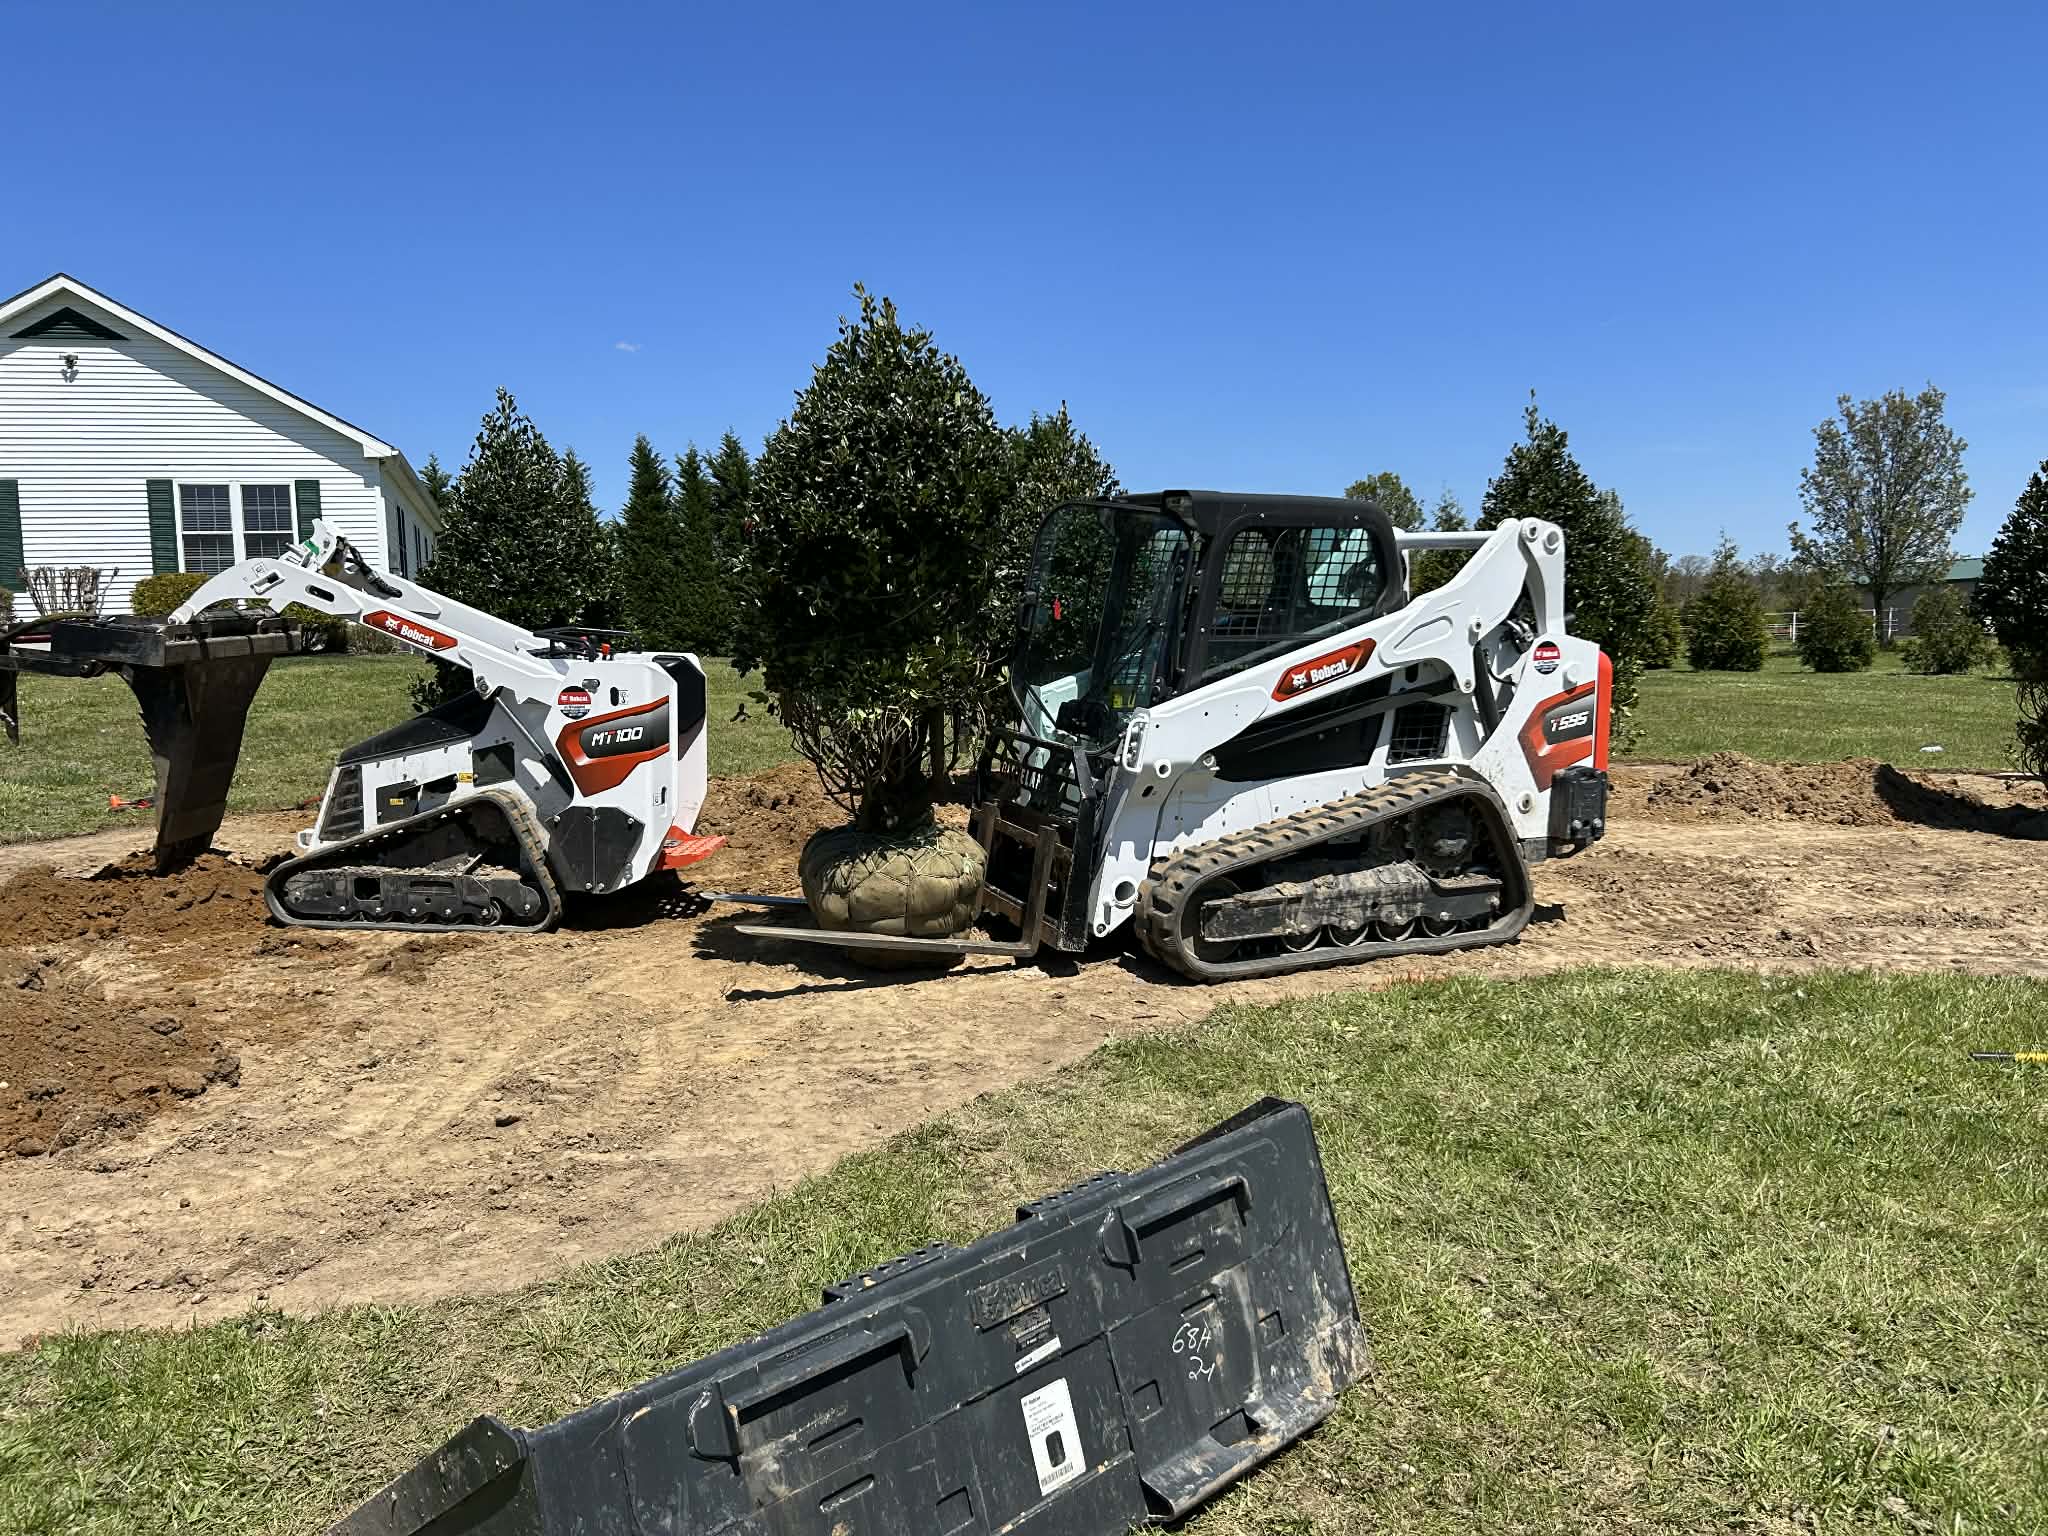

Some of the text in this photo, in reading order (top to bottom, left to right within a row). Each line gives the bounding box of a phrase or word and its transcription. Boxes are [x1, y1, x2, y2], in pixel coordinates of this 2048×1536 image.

[400, 624, 435, 646] Bobcat
[1310, 658, 1349, 684] Bobcat
[1550, 710, 1591, 732] T595
[591, 726, 645, 747] MT100
